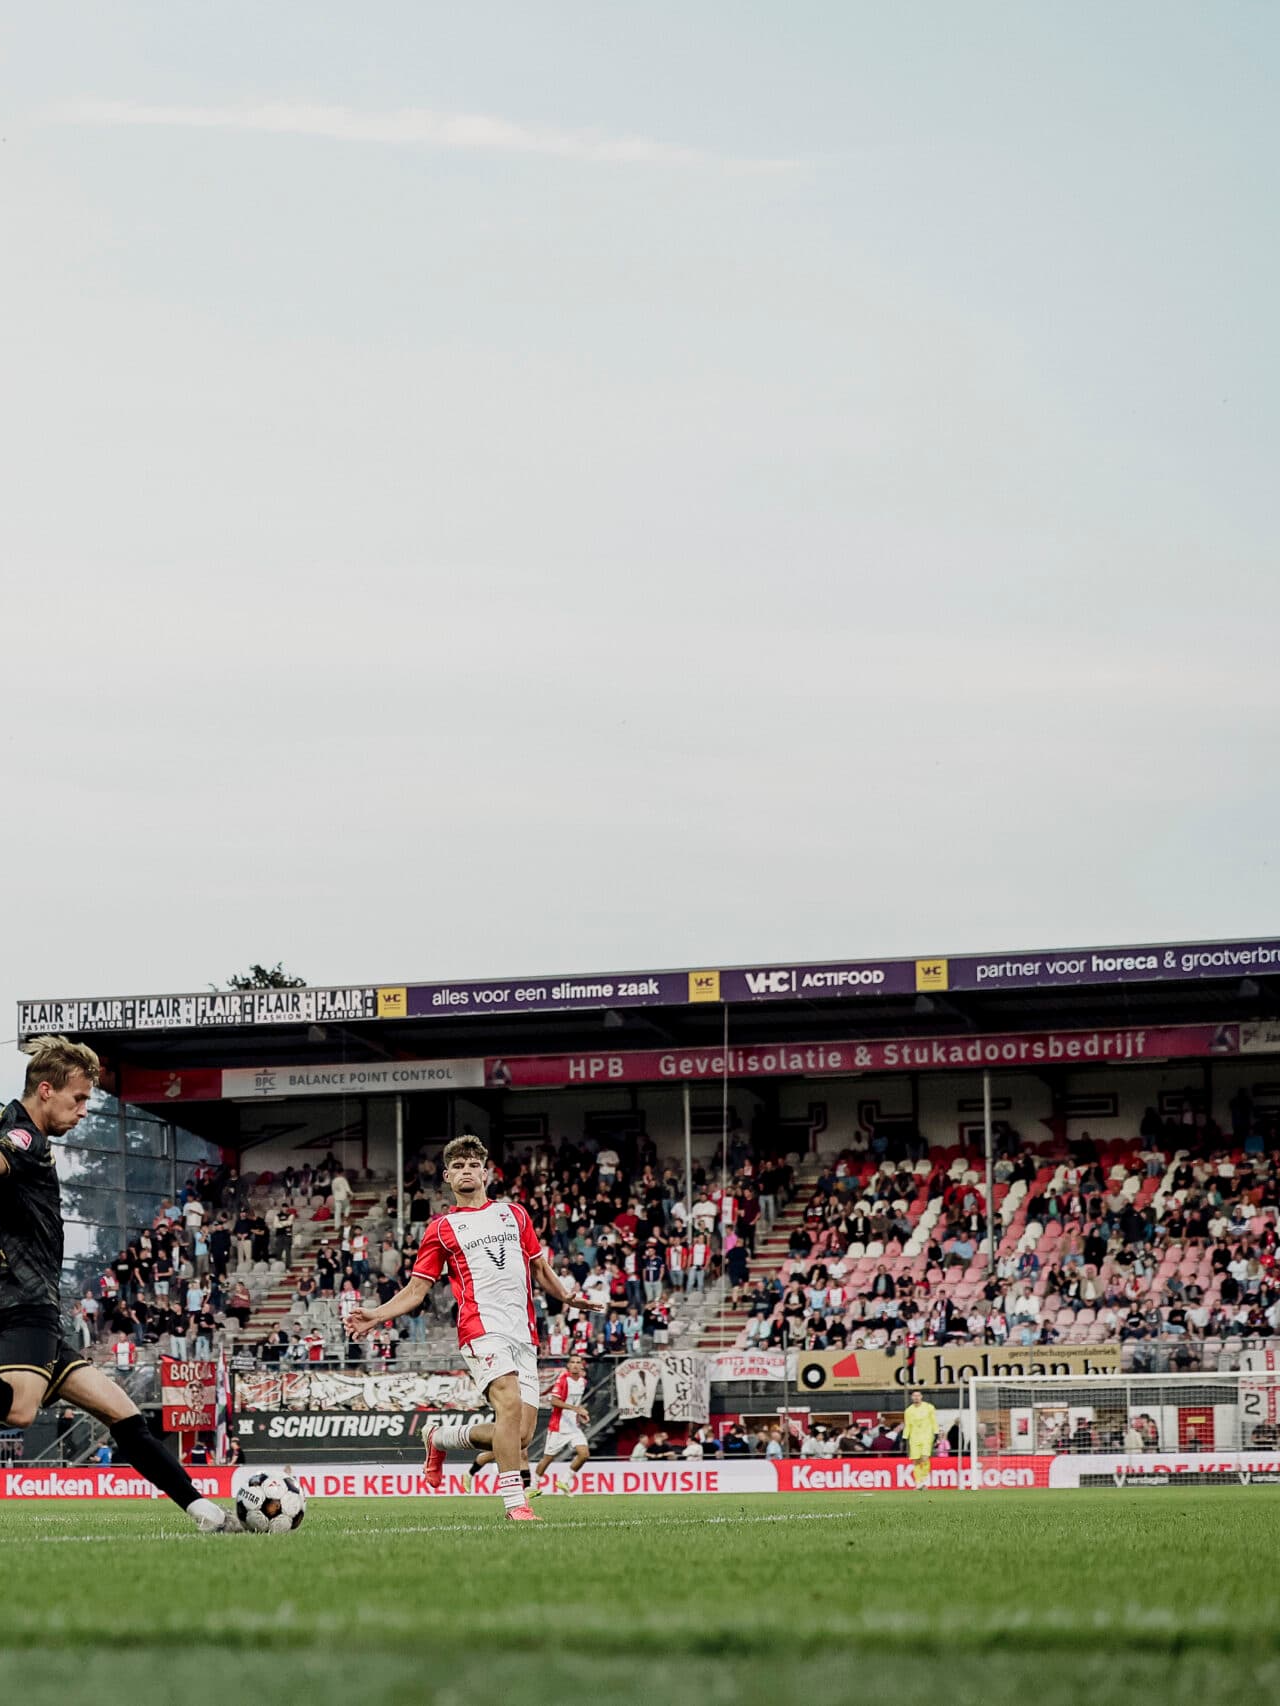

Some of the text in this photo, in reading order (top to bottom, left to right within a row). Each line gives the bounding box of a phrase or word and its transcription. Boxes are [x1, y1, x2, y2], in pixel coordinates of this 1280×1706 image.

[976, 960, 1041, 982] partner
[1046, 960, 1086, 975] voor
[1091, 953, 1158, 973] horeca
[1163, 951, 1177, 969] &
[802, 970, 885, 988] ACTIFOOD
[319, 990, 363, 1011] FLAIR
[432, 978, 660, 1006] alles voor een slimme zaak
[22, 1004, 64, 1024] FLAIR
[79, 1001, 123, 1022] FLAIR
[138, 998, 181, 1019] FLAIR
[197, 996, 242, 1017] FLAIR
[257, 993, 301, 1014] FLAIR
[79, 1020, 123, 1029] FASHION
[138, 1018, 182, 1026] FASHION
[197, 1015, 242, 1025] FASHION
[256, 1012, 302, 1021] FASHION
[318, 1010, 363, 1019] FASHION
[22, 1023, 65, 1031] FASHION
[569, 1031, 1146, 1080] HPB Gevelisolatie & Stukadoorsbedrijf
[288, 1068, 453, 1087] BALANCE POINT CONTROL
[464, 1231, 518, 1250] vandaglas
[934, 1353, 1072, 1385] holman
[268, 1415, 405, 1438] SCHUTRUPS
[5, 1473, 94, 1497] Keuken
[324, 1475, 355, 1496] DE
[624, 1471, 719, 1493] DIVISIE
[792, 1464, 892, 1489] Keuken
